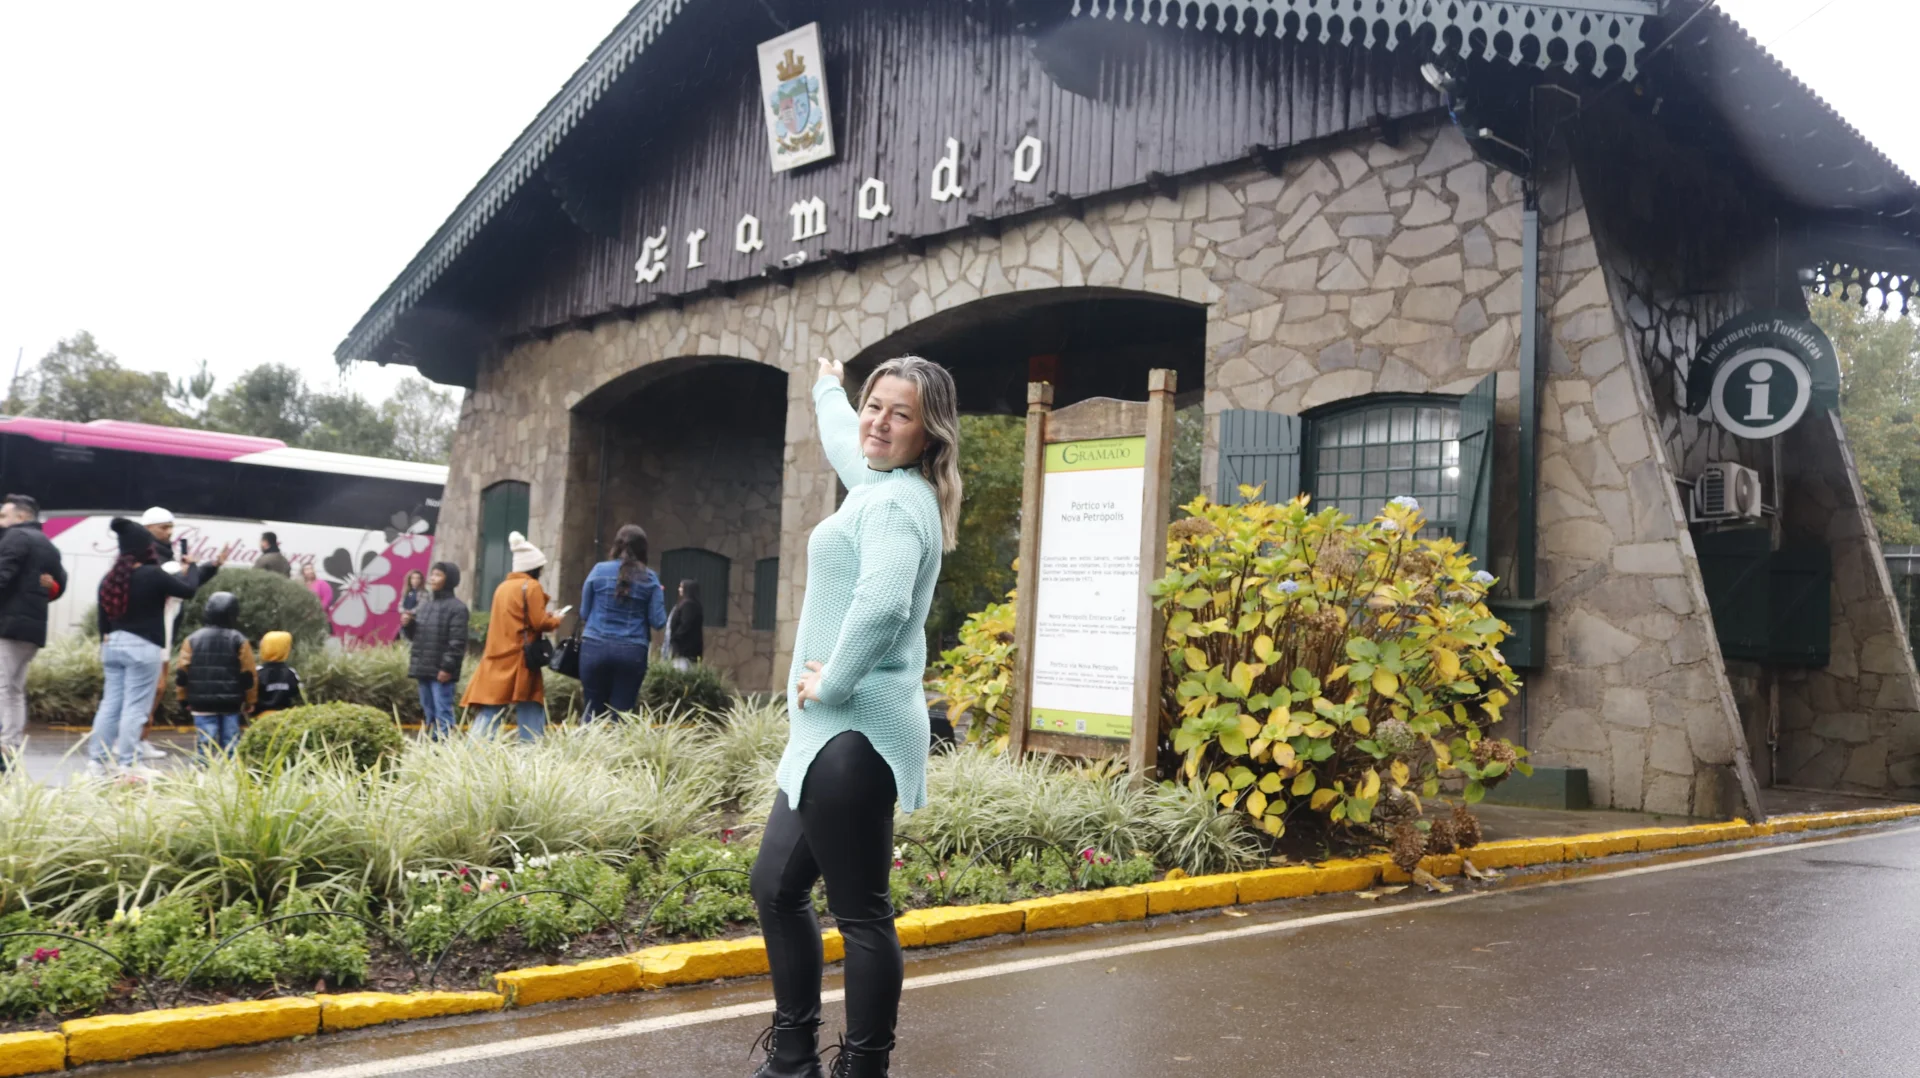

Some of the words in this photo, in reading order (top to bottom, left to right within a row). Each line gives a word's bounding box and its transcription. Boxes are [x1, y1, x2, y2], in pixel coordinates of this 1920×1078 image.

[634, 134, 1042, 284] Gramado
[1701, 322, 1769, 364] Informações
[1773, 319, 1823, 360] Turísticas
[1743, 361, 1774, 420] i
[1061, 513, 1081, 522] Nova
